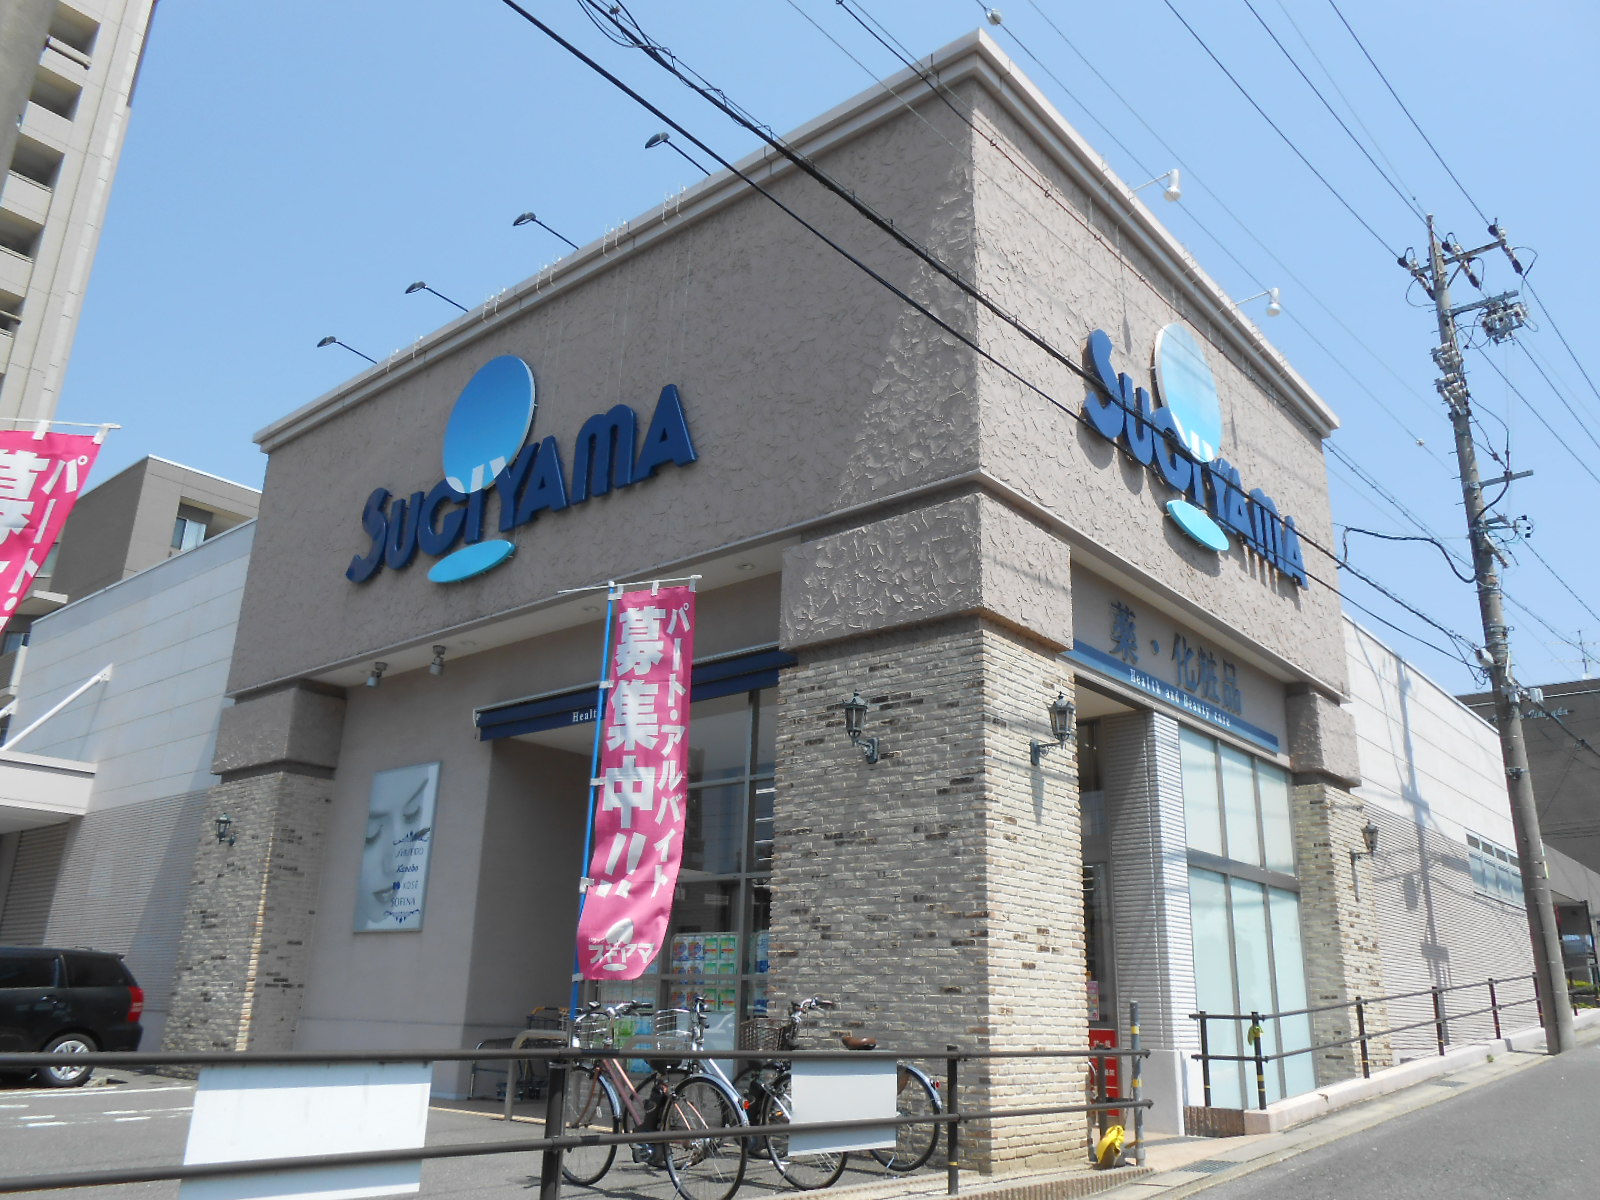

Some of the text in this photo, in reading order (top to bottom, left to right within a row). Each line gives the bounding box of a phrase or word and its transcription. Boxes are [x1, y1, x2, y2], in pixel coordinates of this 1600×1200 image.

[345, 383, 697, 584] SUGIYAMA
[1082, 328, 1309, 591] SUGIYAMA
[572, 708, 598, 723] Healt
[1130, 668, 1161, 694] Health
[1165, 689, 1180, 703] and
[1183, 694, 1210, 719] Beauty
[588, 943, 655, 964] スギヤマ
